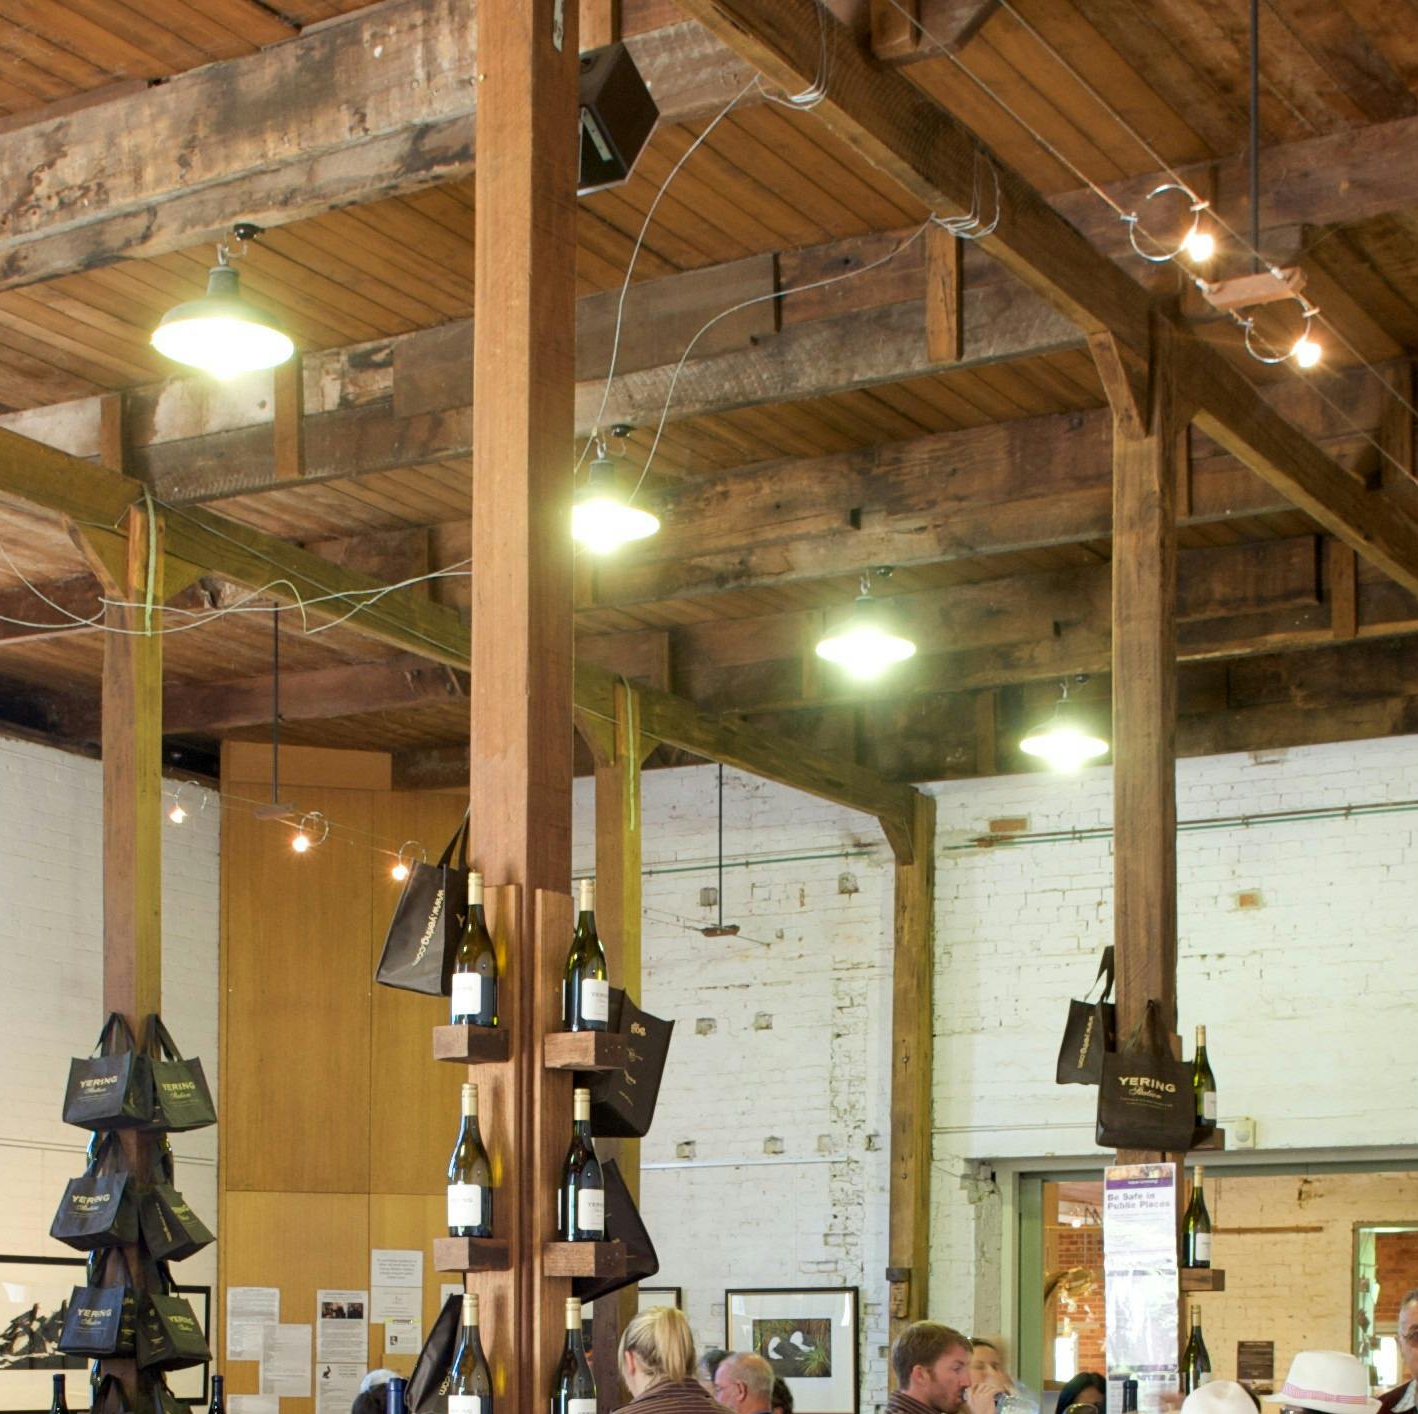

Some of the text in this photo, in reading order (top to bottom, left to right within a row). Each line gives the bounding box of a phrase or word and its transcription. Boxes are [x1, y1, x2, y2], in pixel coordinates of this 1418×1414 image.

[80, 1075, 118, 1088] YERING
[161, 1080, 196, 1091] YERING
[1118, 1075, 1177, 1093] YERING
[71, 1193, 111, 1205] YERING
[1107, 1200, 1171, 1210] Public Places
[76, 1307, 112, 1318] YERING
